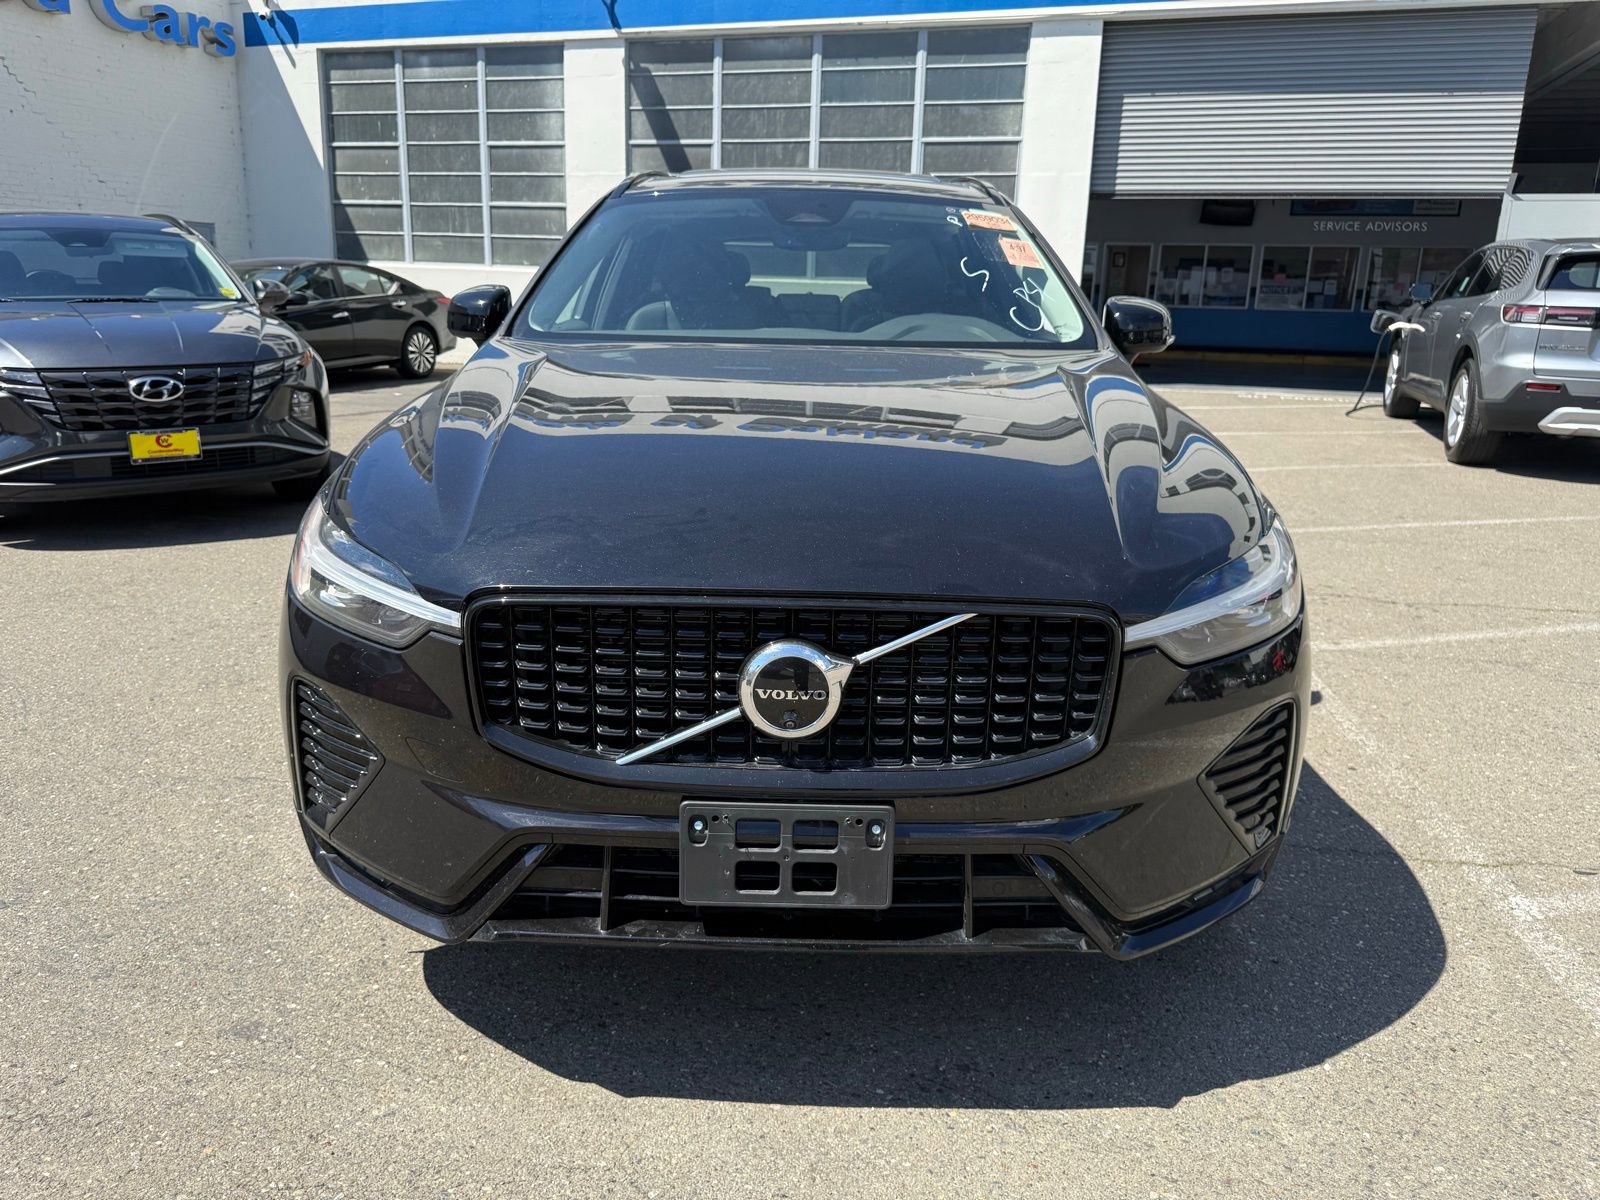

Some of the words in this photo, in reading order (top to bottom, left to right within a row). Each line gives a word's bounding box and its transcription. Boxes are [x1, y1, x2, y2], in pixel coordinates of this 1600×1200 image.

[1312, 220, 1361, 232] SERVICE
[1365, 220, 1428, 233] ADVISORS
[754, 688, 827, 701] VOLVO
